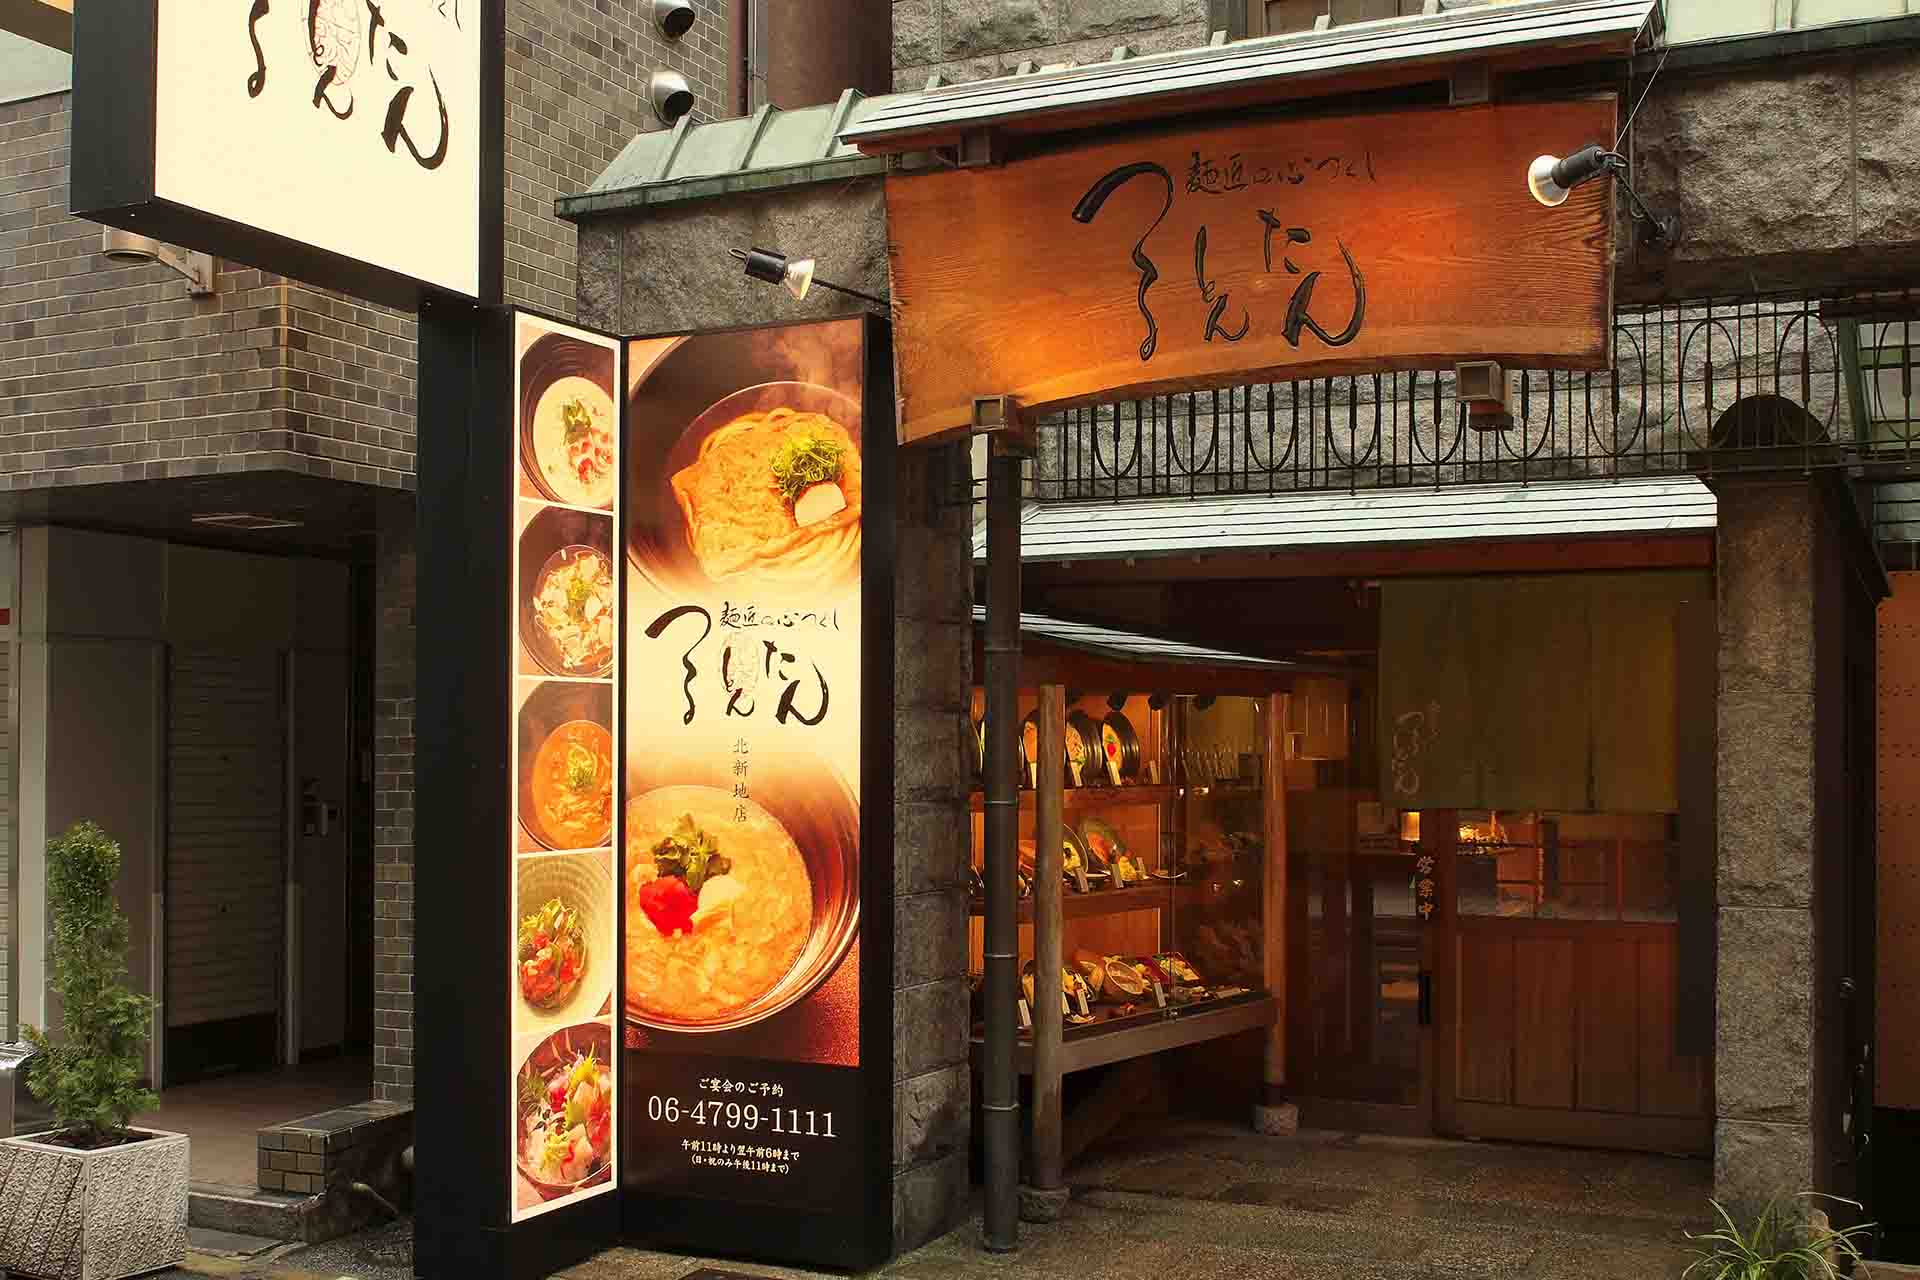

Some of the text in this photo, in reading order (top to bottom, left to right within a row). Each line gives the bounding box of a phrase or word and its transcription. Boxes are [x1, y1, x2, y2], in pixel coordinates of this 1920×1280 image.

[732, 737, 750, 824] 北新地店
[1415, 855, 1436, 921] 営業中
[699, 1078, 784, 1097] ご宴会のご予約
[648, 1095, 837, 1138] 06-4799-1111
[681, 1138, 800, 1162] 午前11時より翌午前6時まで
